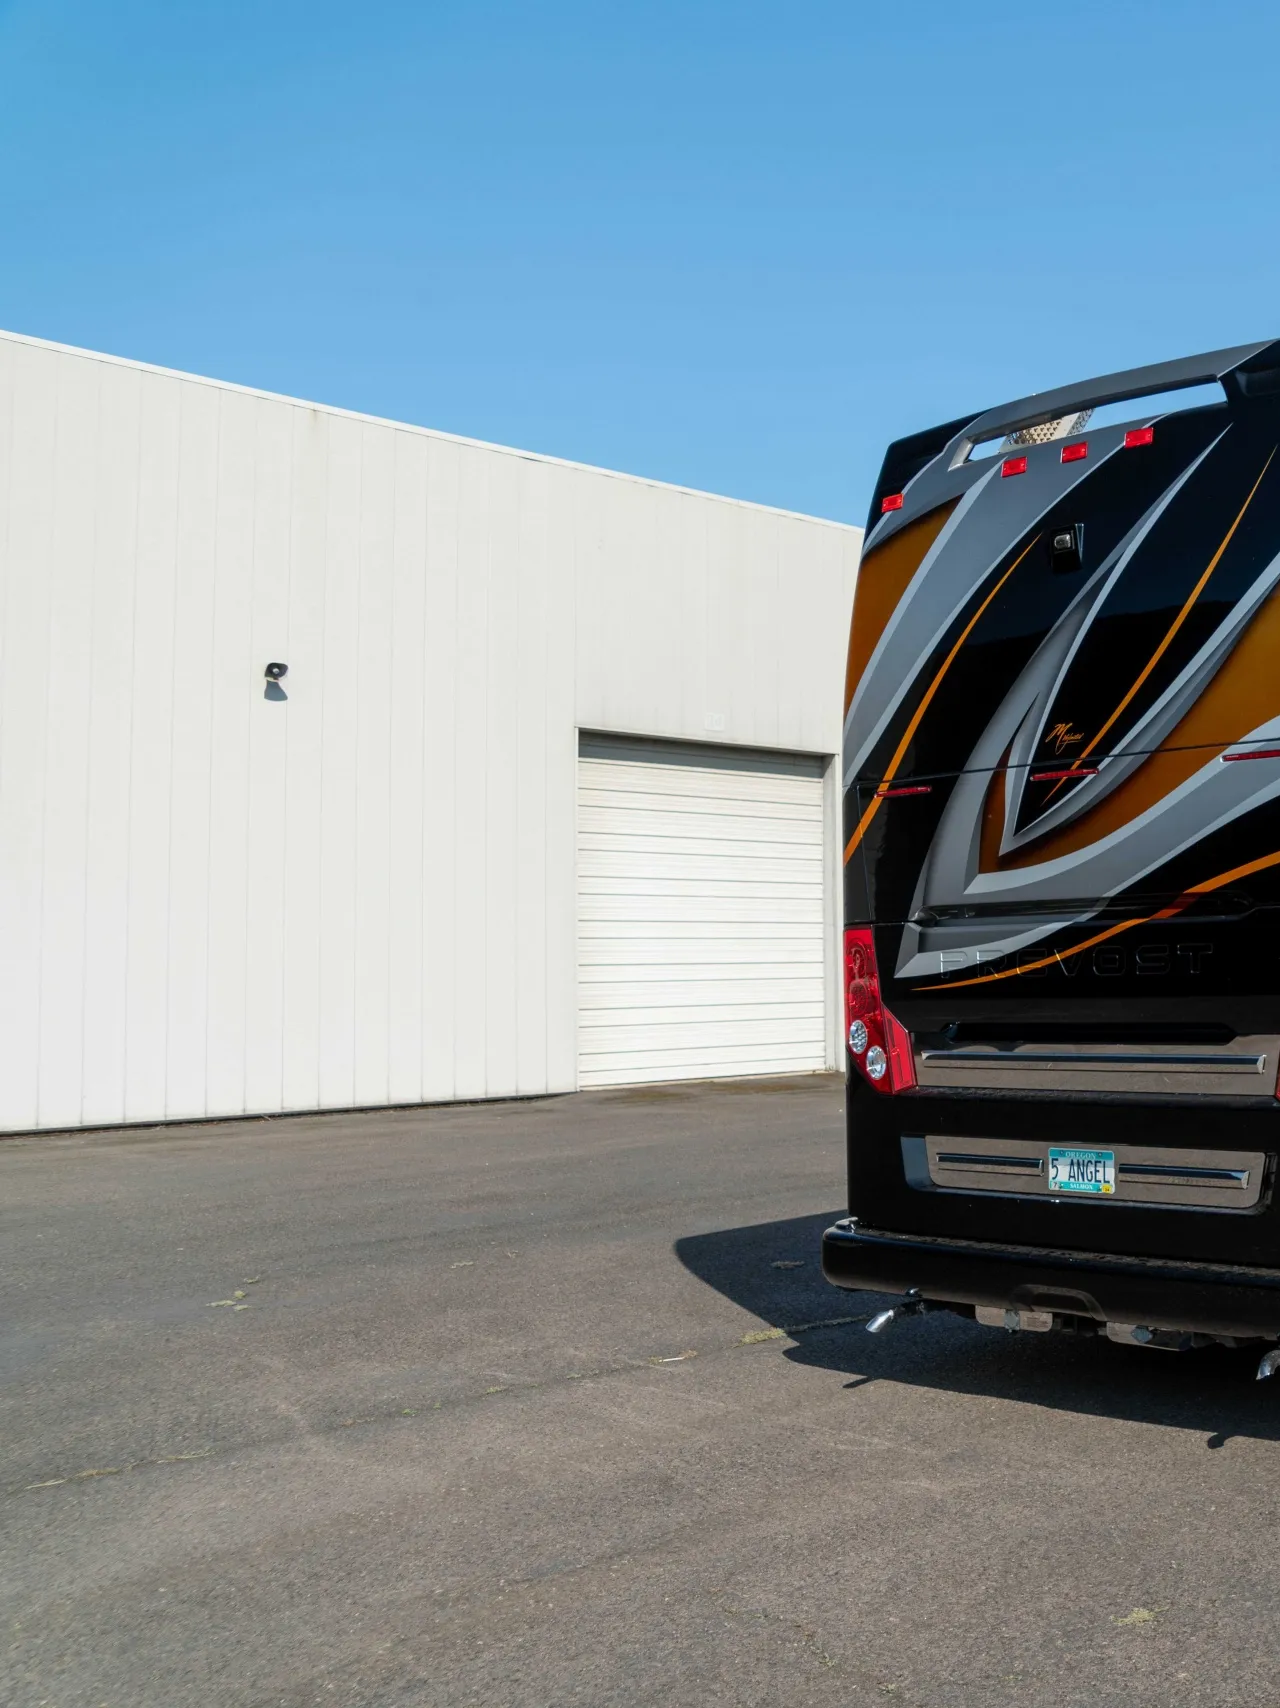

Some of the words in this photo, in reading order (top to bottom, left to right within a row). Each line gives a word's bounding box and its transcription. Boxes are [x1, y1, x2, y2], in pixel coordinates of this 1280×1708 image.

[1065, 1151, 1096, 1160] OREGON
[1051, 1158, 1059, 1180] 5
[1068, 1159, 1111, 1183] ANGEL
